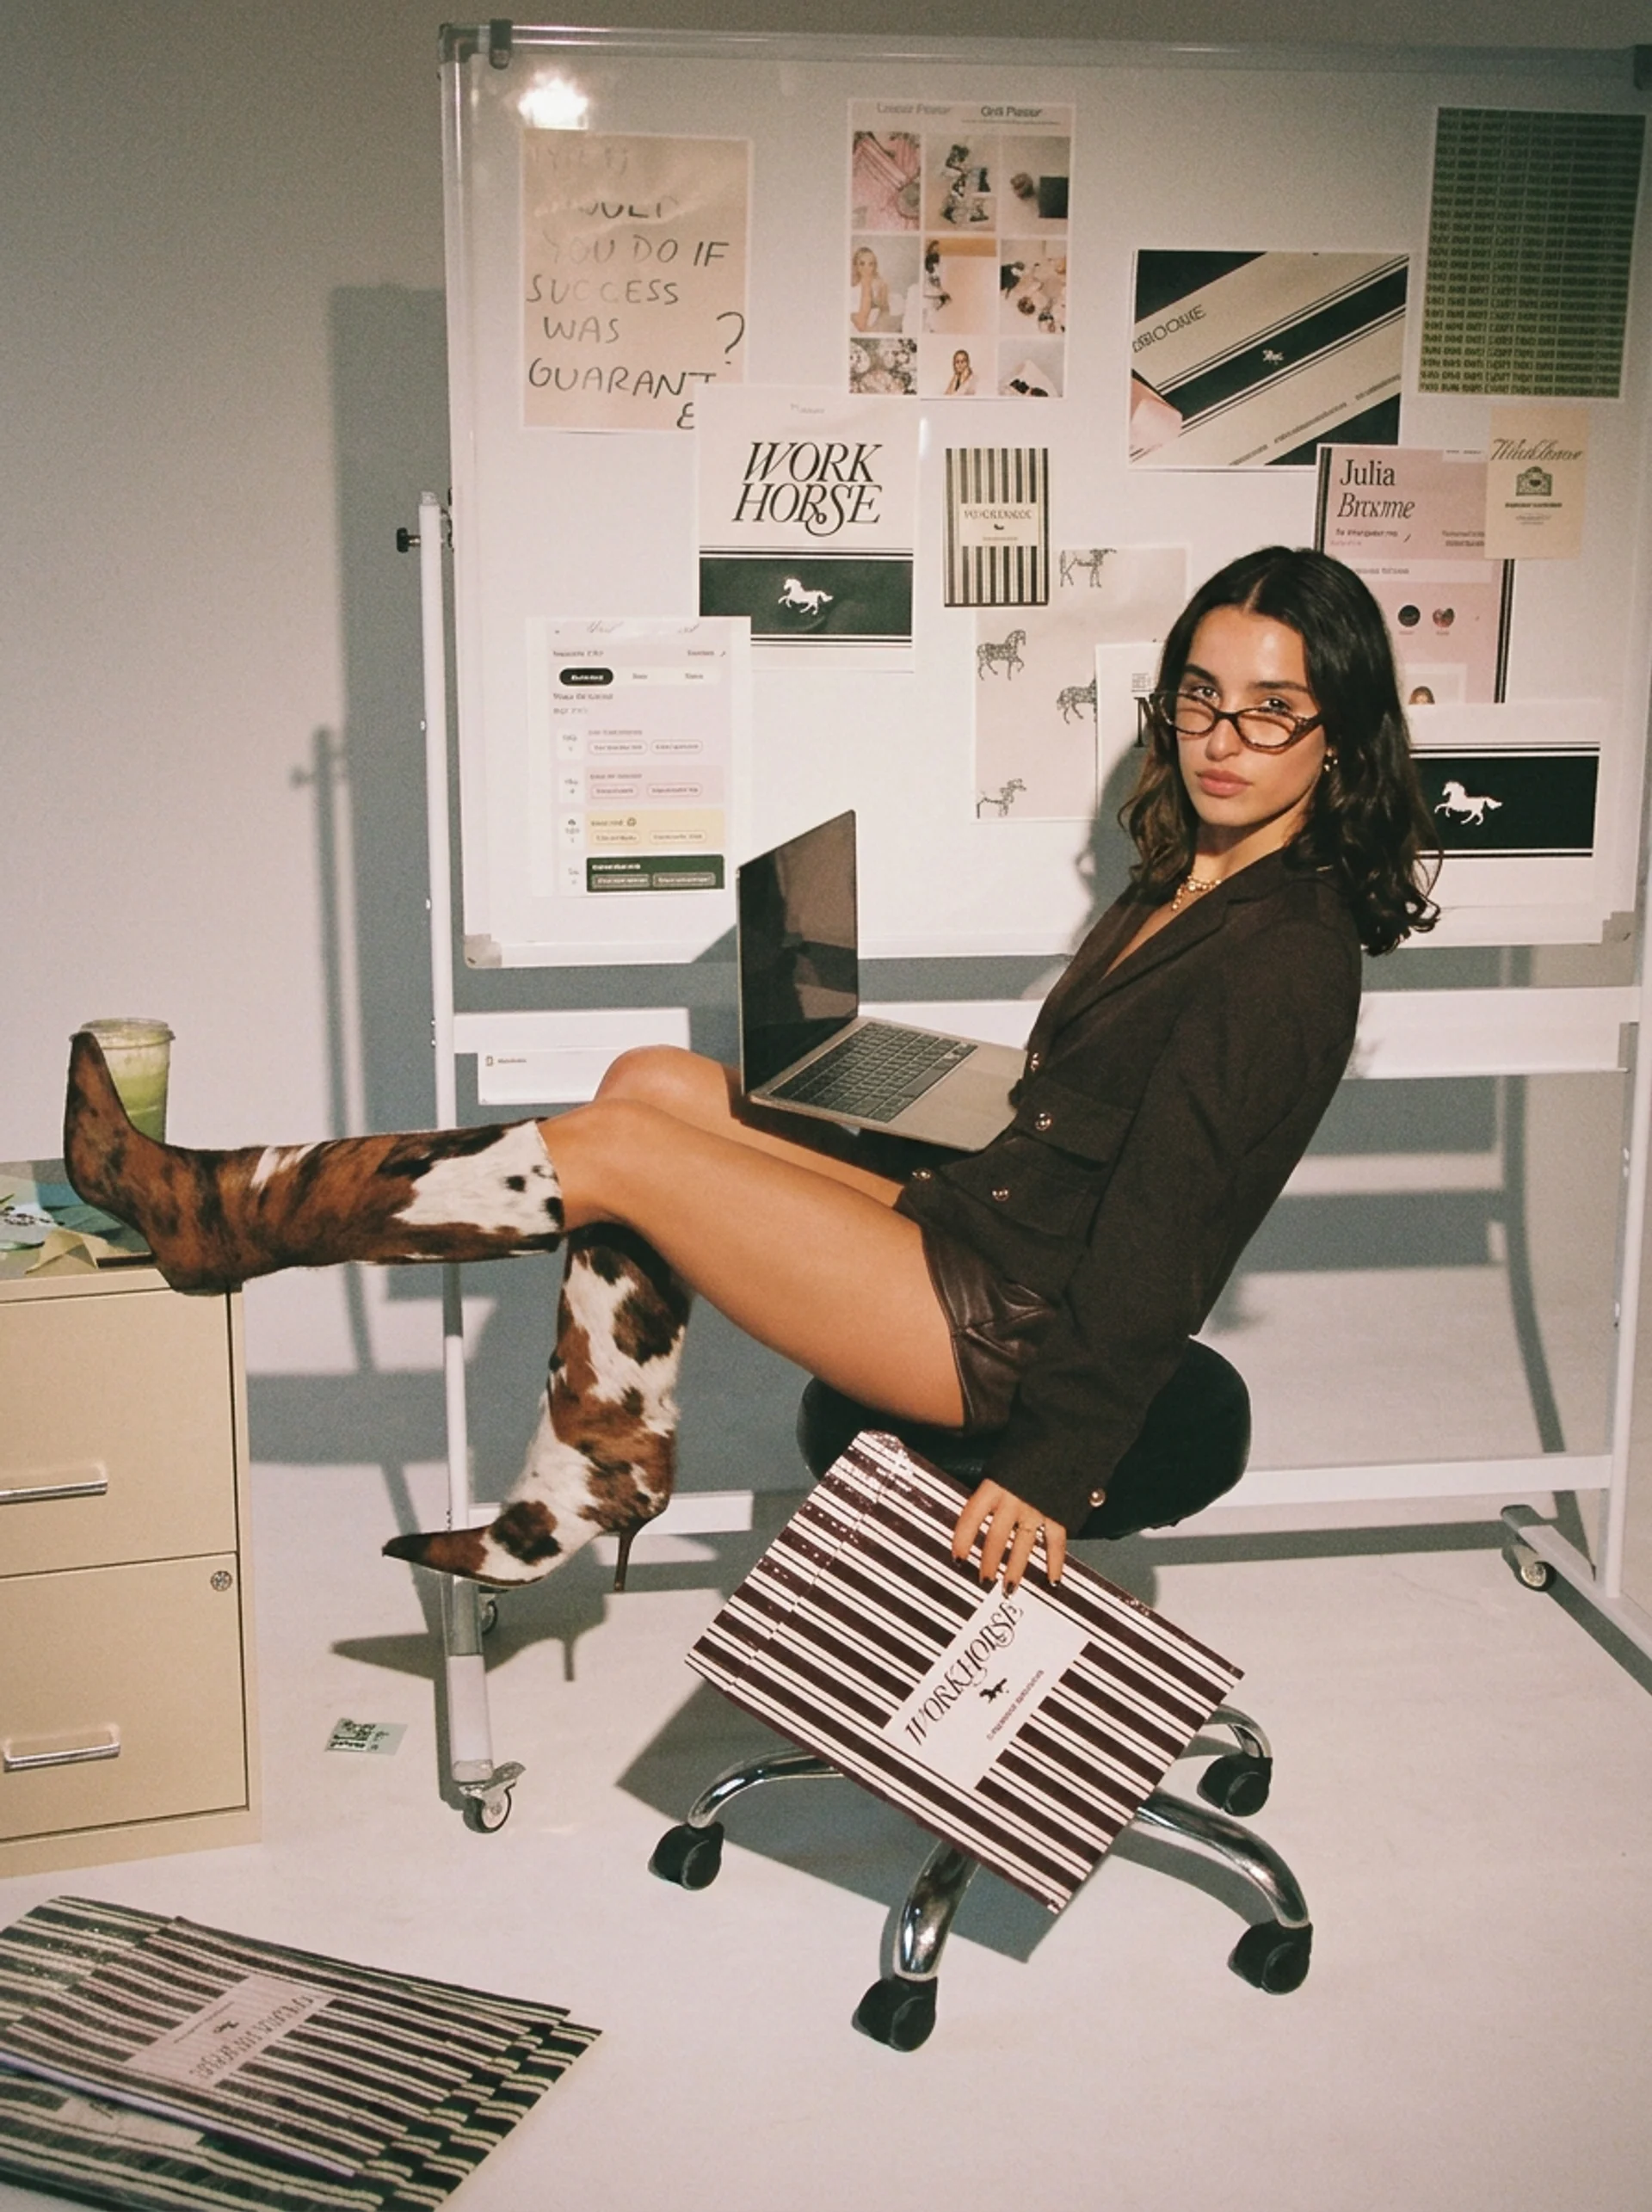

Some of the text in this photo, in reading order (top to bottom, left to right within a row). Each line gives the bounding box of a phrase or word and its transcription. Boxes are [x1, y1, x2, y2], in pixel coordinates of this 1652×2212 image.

[633, 234, 679, 263] DO
[693, 241, 730, 267] IF
[526, 274, 679, 305] SUCCESS
[544, 315, 620, 344] WAS
[743, 441, 884, 483] WORK
[1340, 459, 1396, 487] Julia
[731, 482, 884, 538] HORSE
[904, 1600, 1025, 1747] WORKHORSE
